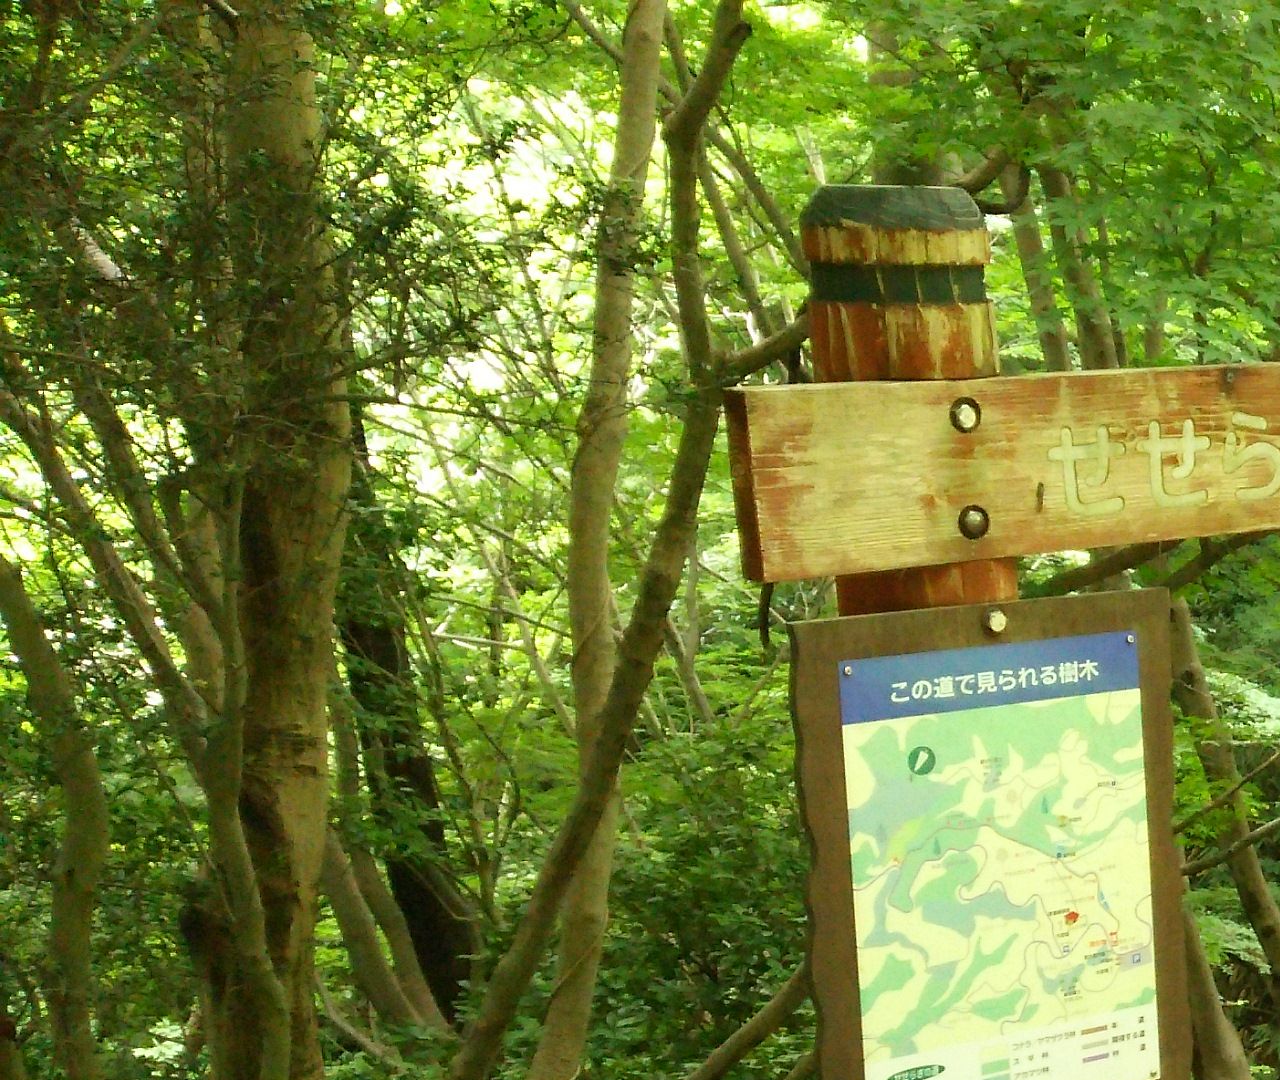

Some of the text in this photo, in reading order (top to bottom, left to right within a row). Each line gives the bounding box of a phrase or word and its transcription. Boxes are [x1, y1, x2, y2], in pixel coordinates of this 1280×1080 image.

[889, 659, 1100, 704] この道で見られる樹木
